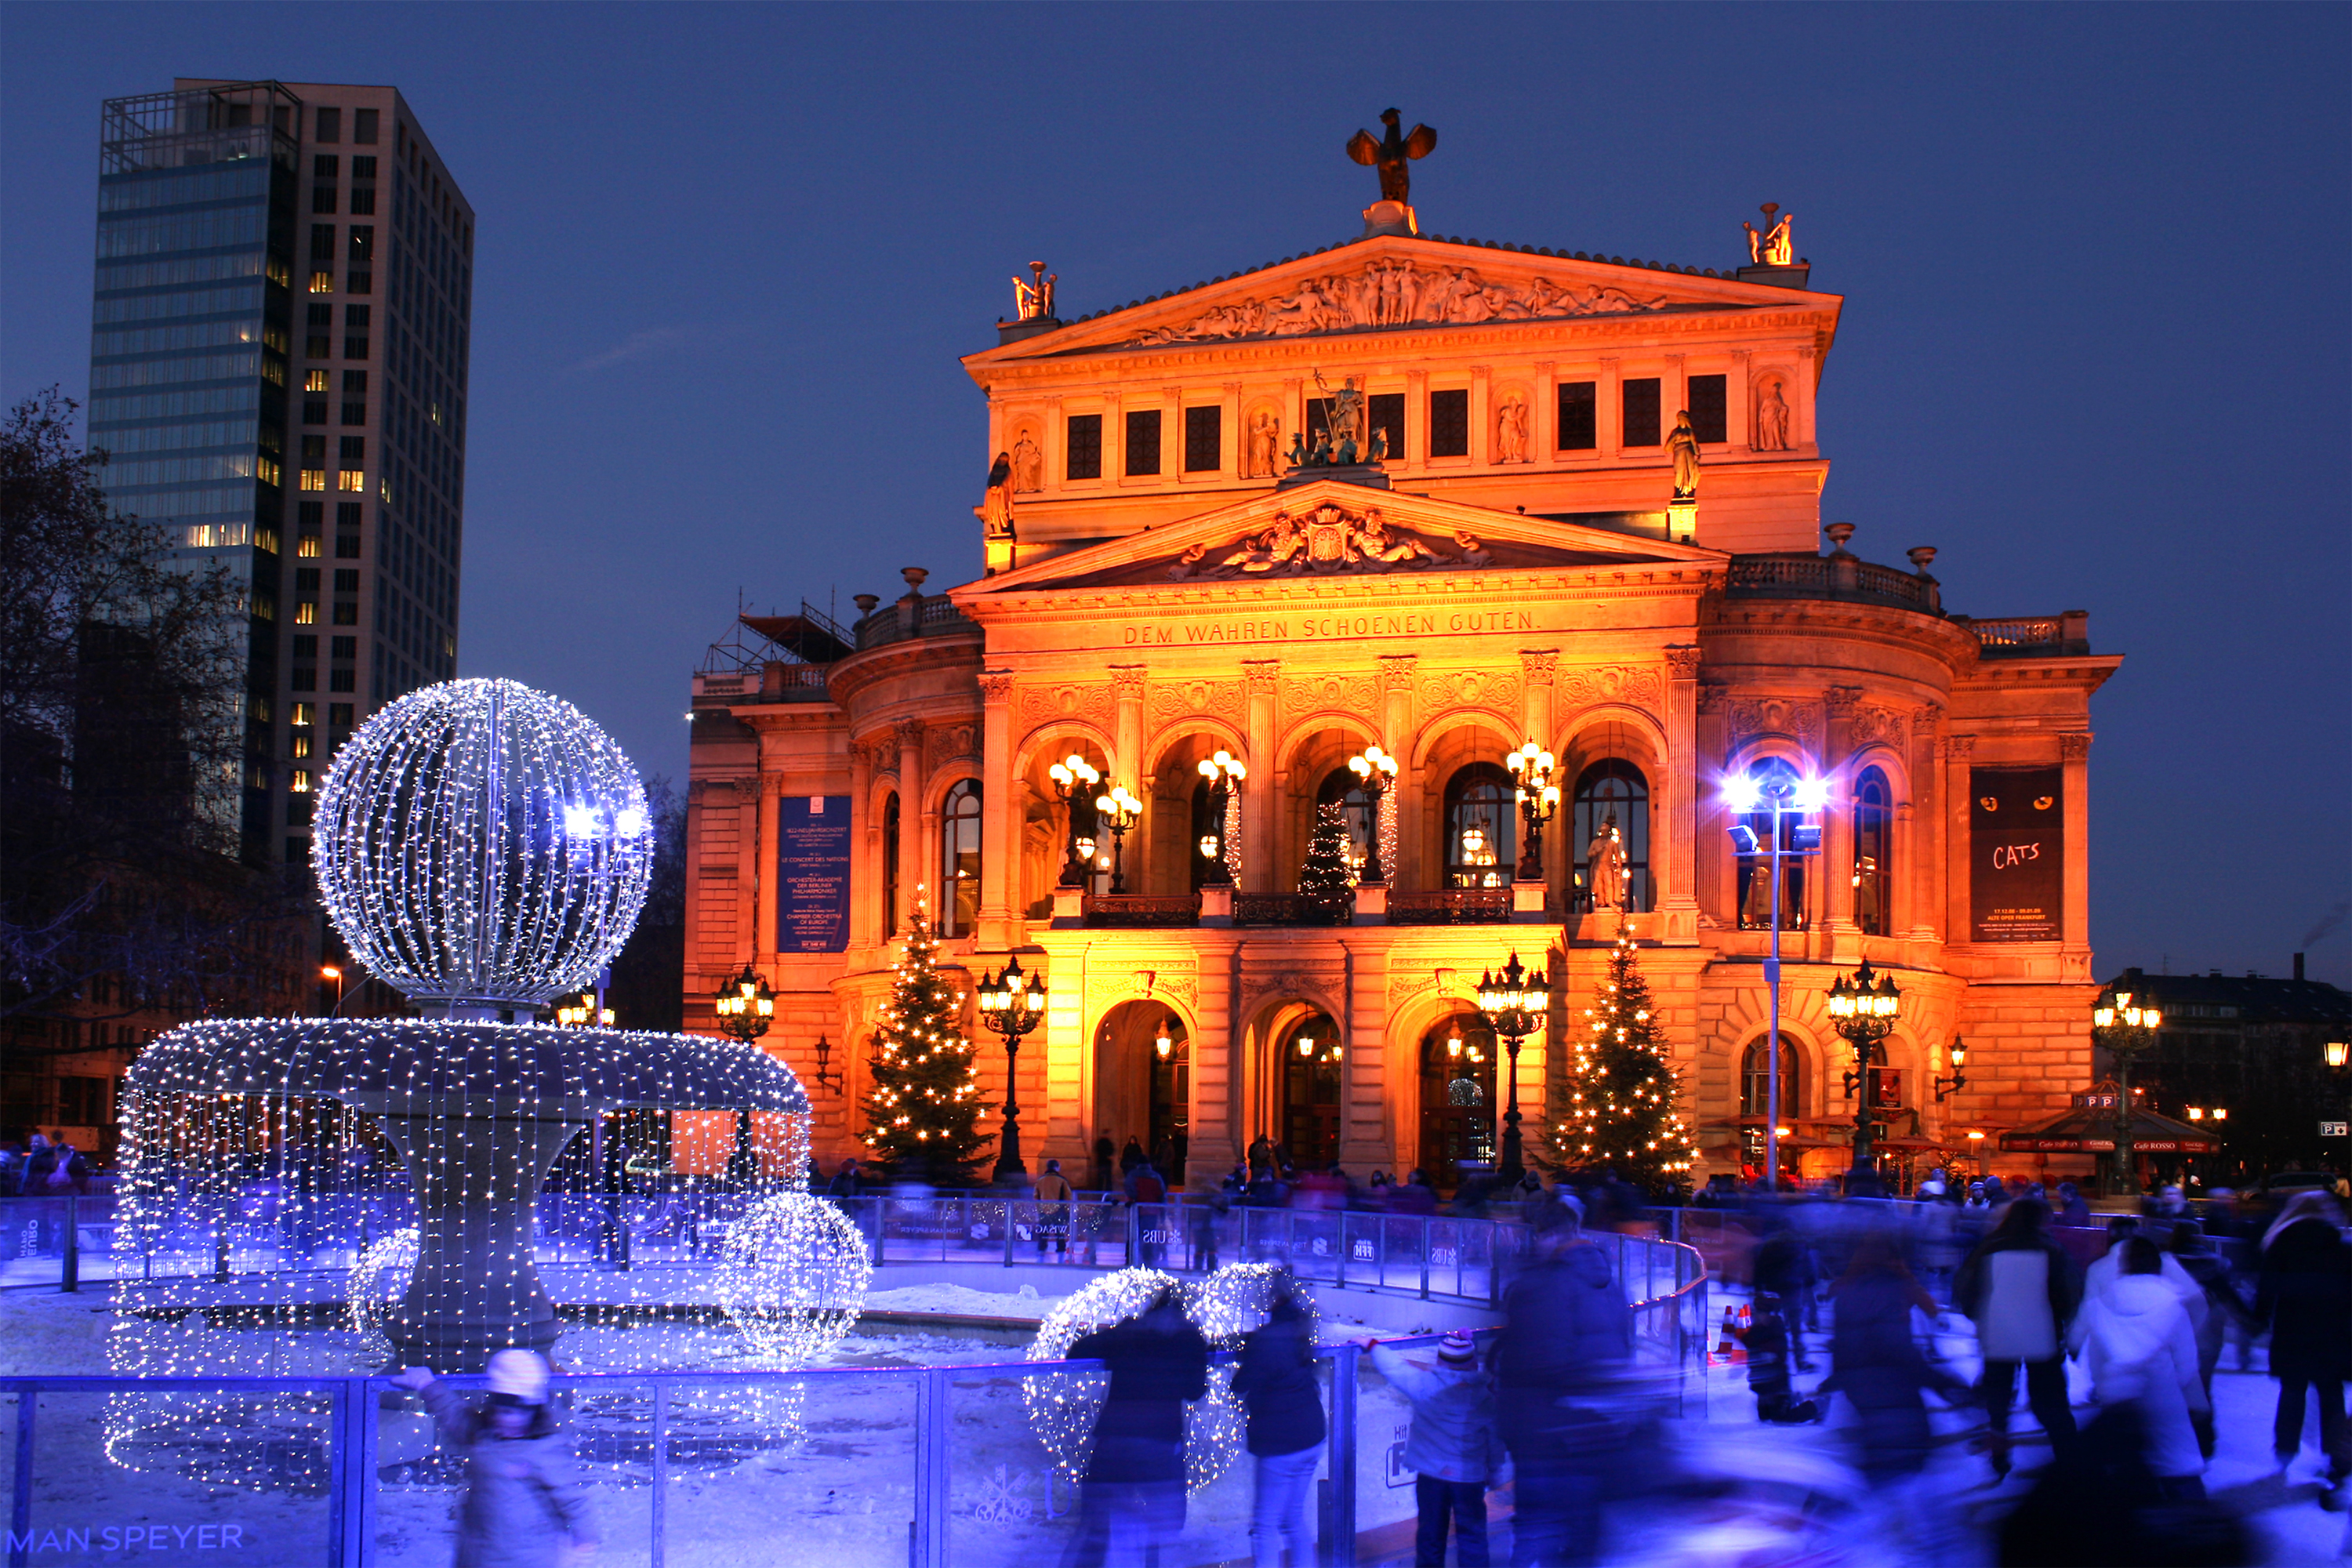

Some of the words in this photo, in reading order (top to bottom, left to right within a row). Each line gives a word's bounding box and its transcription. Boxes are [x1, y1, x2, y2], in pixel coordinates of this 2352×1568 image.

[1124, 626, 1173, 644] DEM
[1185, 619, 1288, 641] WAHREN
[1302, 614, 1435, 636] SCHOENEN
[1450, 611, 1541, 632] GUTEN.
[1993, 842, 2040, 869] CATS
[2133, 1142, 2149, 1150] Cafe
[1394, 1424, 1407, 1440] Hit
[5, 1526, 90, 1554] MAN
[101, 1524, 243, 1552] SPEYER
